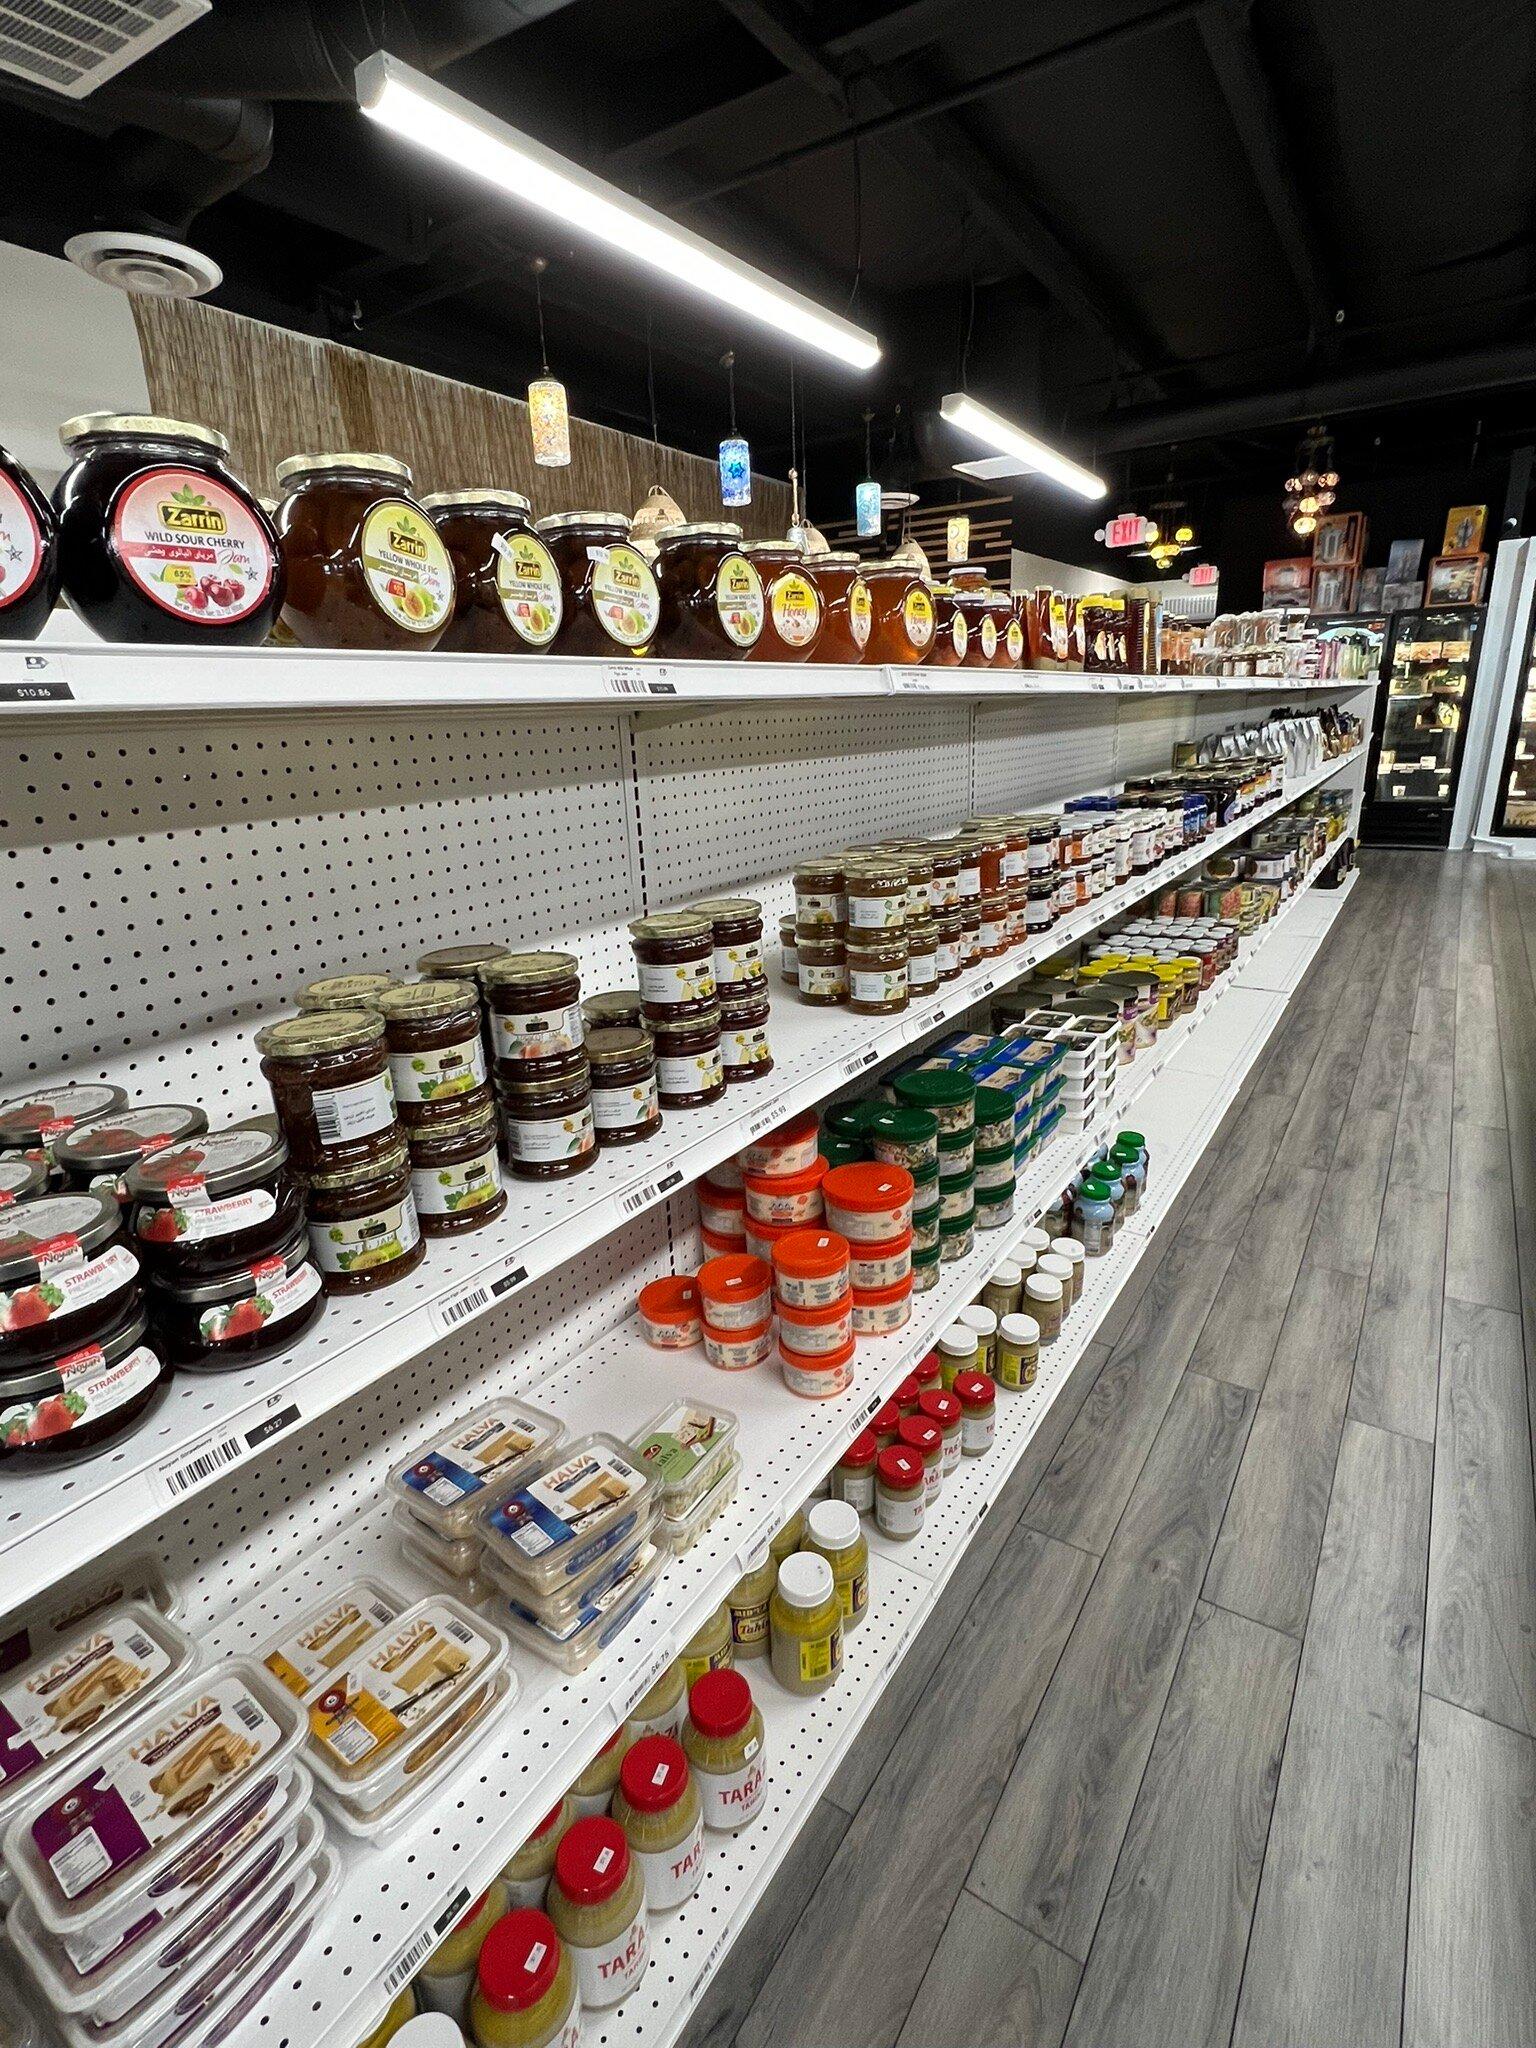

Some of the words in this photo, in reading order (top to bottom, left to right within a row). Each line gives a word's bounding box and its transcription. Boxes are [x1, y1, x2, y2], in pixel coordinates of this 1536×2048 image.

[166, 507, 223, 531] Zarrin
[145, 531, 173, 543] WILD
[176, 534, 203, 546] SOUR
[207, 538, 244, 549] CHERRY
[1113, 519, 1140, 545] EXIT
[393, 533, 425, 557] Zarrin
[217, 549, 250, 566] Jam
[379, 549, 403, 564] YELLOW
[405, 557, 426, 571] WHOLE
[428, 566, 438, 575] FIG
[1195, 568, 1213, 582] EXIT
[781, 603, 808, 620] Honey
[17, 687, 51, 697] $10.86
[171, 1184, 202, 1198] Noyan
[43, 1246, 78, 1265] Noyan
[66, 1357, 101, 1377] Noyan
[88, 1356, 140, 1395] STRAWBERRY
[263, 1418, 282, 1434] $6.27
[452, 1417, 500, 1449] HALVA
[544, 1454, 596, 1489] HALVA
[297, 1603, 357, 1648] HALVA
[368, 1620, 432, 1669] HALVA
[26, 1633, 110, 1692] HALVA
[651, 1650, 669, 1675] $6.75
[130, 1696, 217, 1761] HALVA
